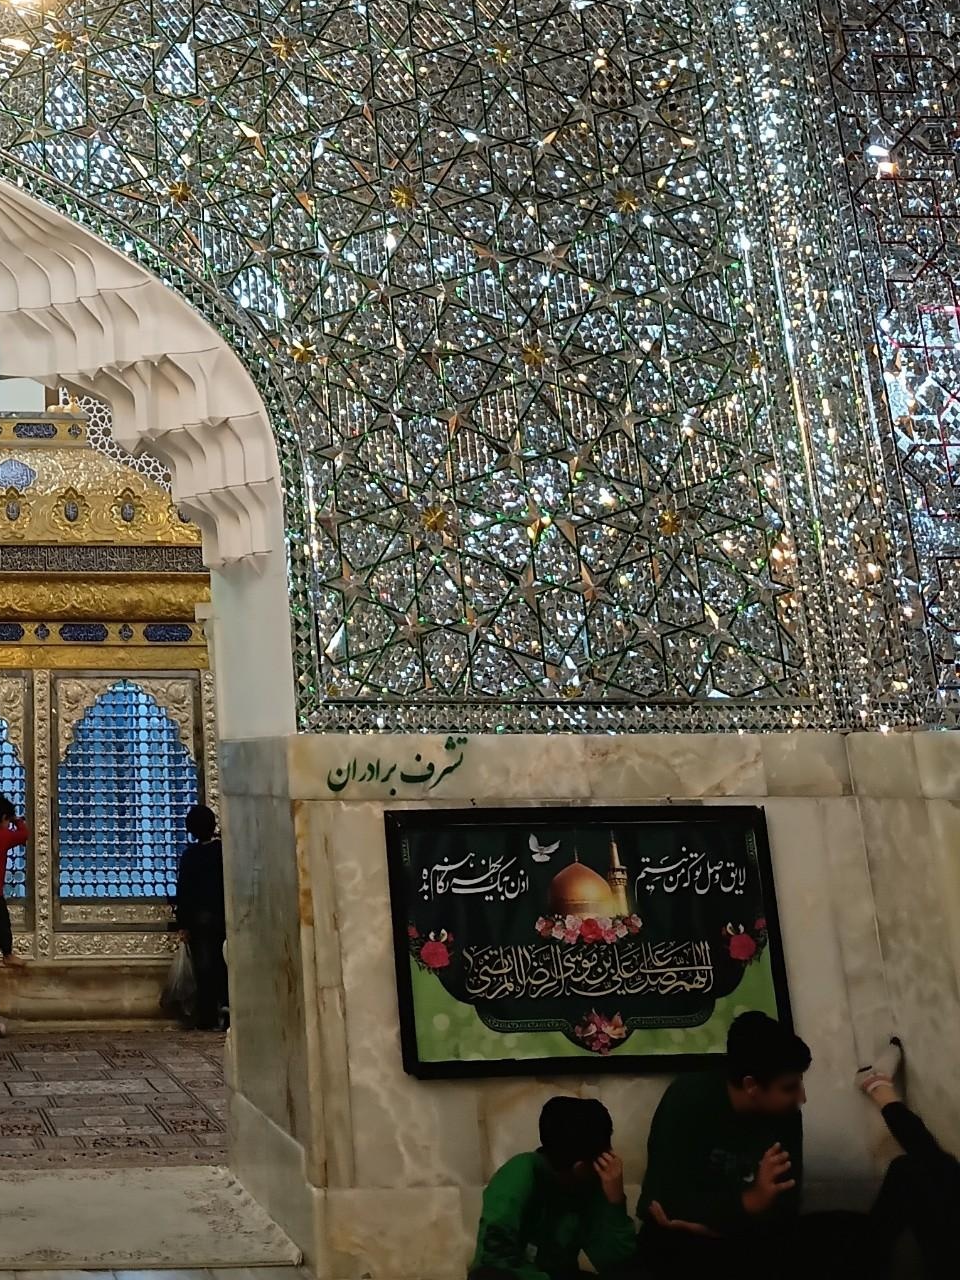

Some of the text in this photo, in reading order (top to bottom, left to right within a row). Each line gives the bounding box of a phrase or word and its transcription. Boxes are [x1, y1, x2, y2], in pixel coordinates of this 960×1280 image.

[327, 735, 468, 796] تشرف برادران
[504, 869, 529, 900] اذن
[634, 846, 690, 904] نیستم
[663, 867, 686, 893] من
[695, 859, 724, 895] وصل
[720, 861, 747, 895] لایق
